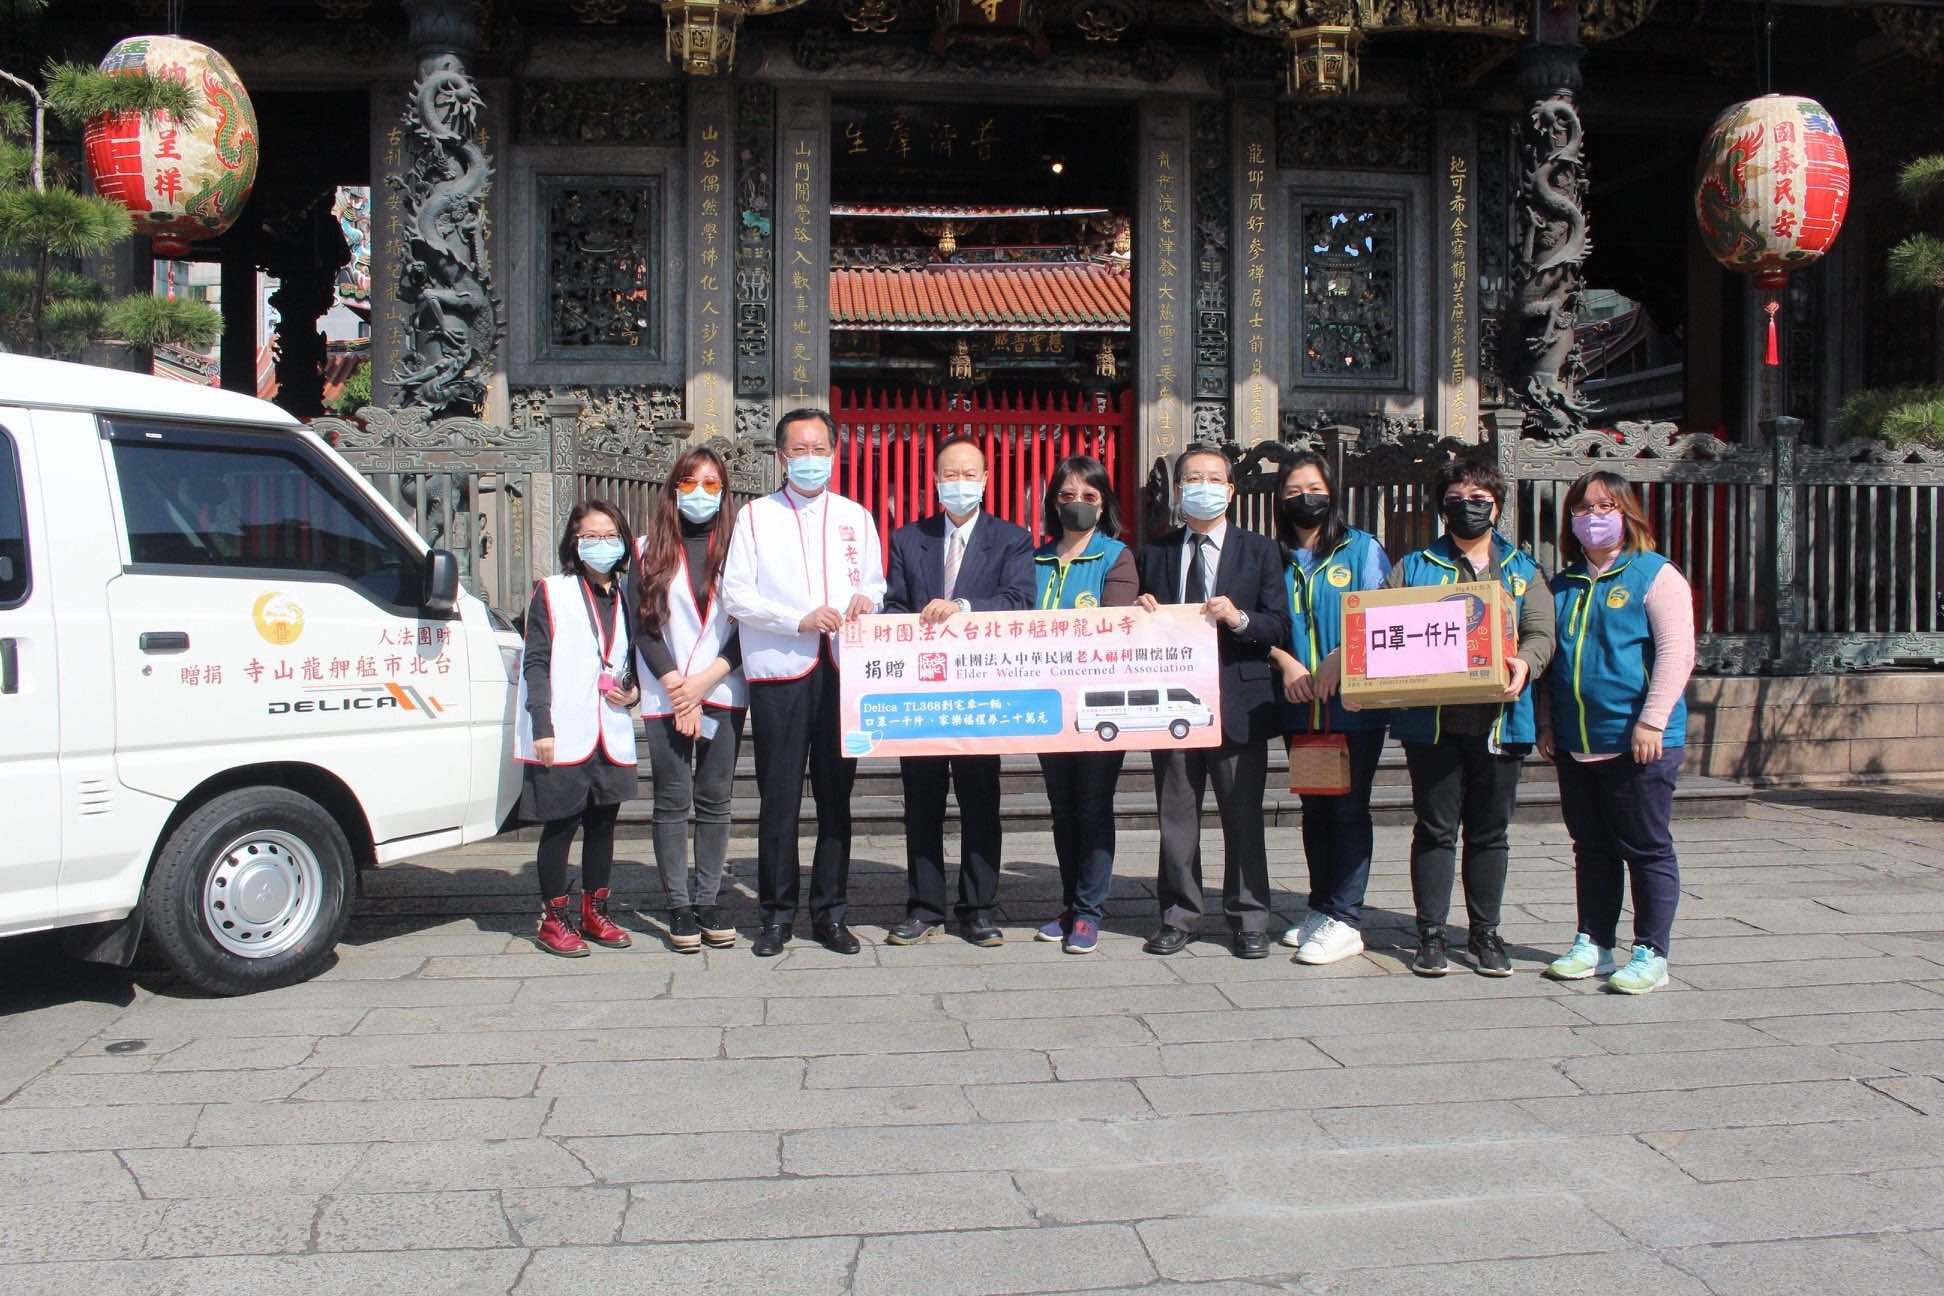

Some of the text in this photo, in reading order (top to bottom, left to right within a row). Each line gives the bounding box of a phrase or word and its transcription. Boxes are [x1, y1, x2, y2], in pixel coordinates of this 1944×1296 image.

[1771, 121, 1799, 239] 國泰民安
[378, 626, 452, 647] 財團法人
[874, 615, 1136, 643] 財團法人台北市艋舺龍山寺
[1371, 621, 1461, 651] 口罩一仟片
[954, 646, 1194, 668] 社團法人中華民國老人福利關懷協會
[181, 652, 452, 686] 台北市艋舺龍山寺 捐贈
[865, 659, 905, 680] 捐贈
[956, 662, 1194, 680] Elder Welfare Concerned Association
[268, 696, 397, 715] DELICA
[863, 703, 898, 713] Delica
